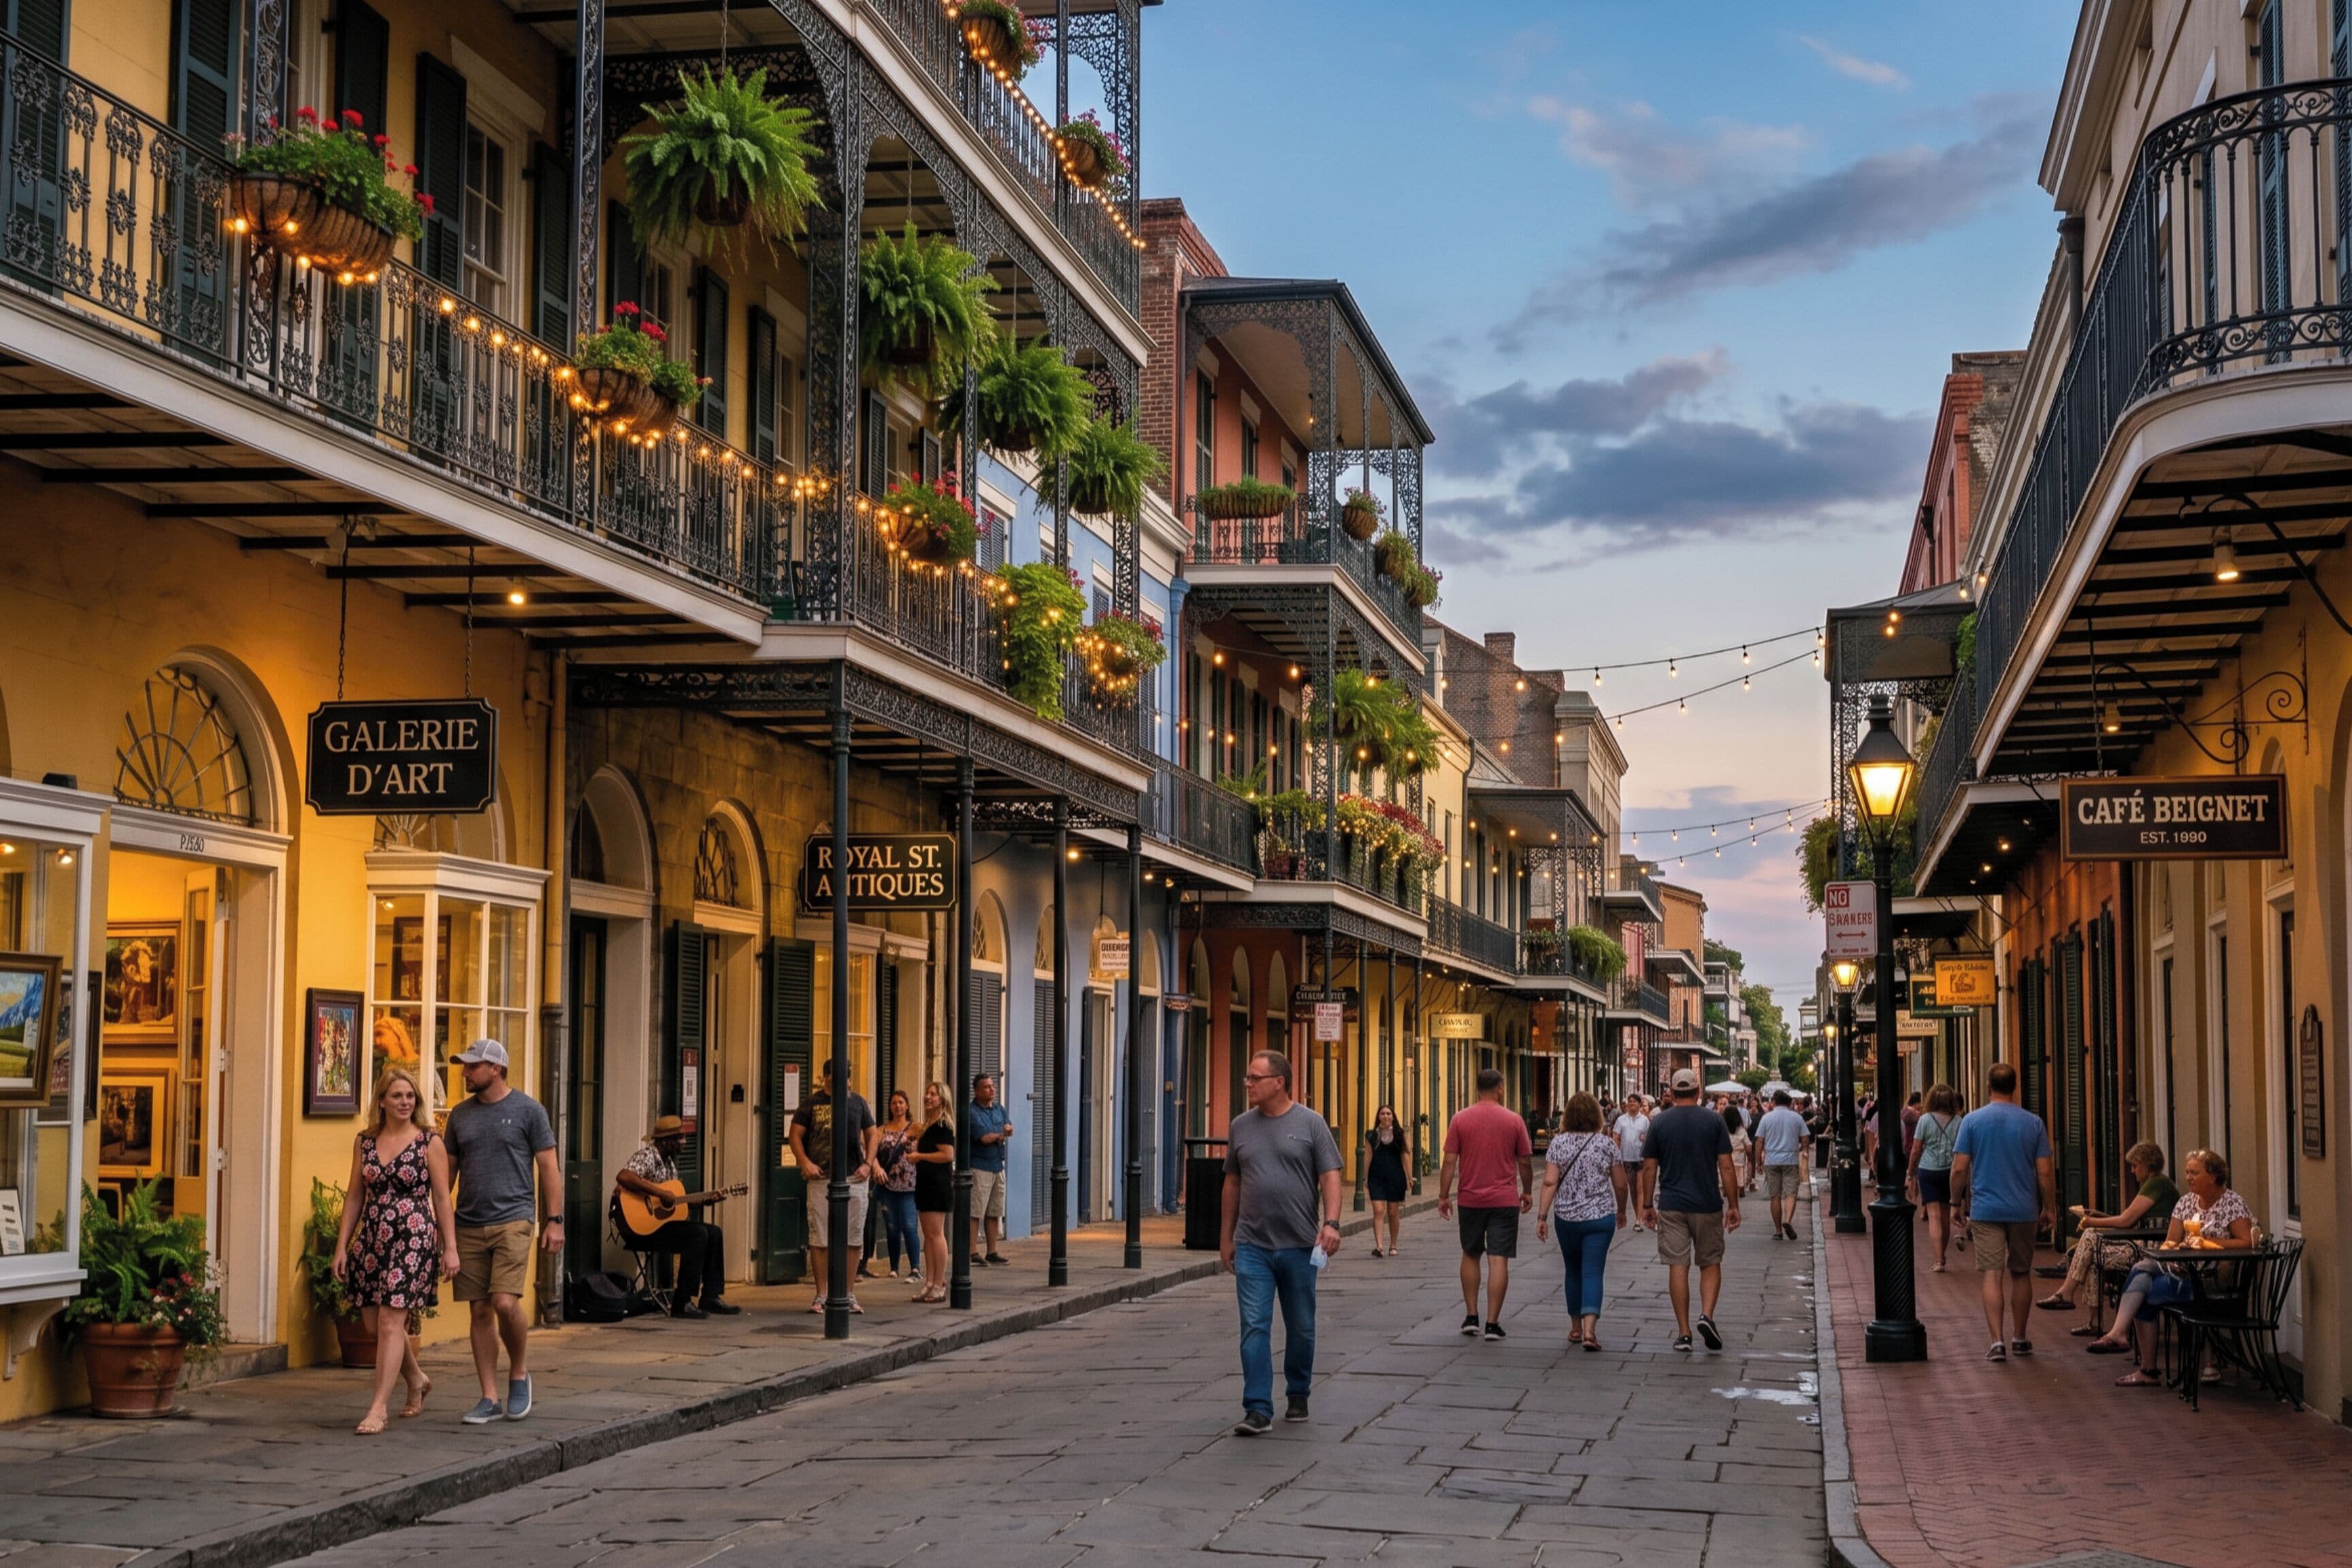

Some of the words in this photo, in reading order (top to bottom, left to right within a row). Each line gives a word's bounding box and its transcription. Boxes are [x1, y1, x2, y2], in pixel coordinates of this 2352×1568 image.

[325, 719, 478, 752] GALERIE
[347, 763, 453, 795] D'ART
[2078, 789, 2145, 825] CAFÉ
[2153, 794, 2268, 823] BEIGNET
[2140, 832, 2170, 844] EST.
[2174, 831, 2207, 843] 1990
[909, 845, 942, 868] ST.
[1829, 889, 1848, 906] NO
